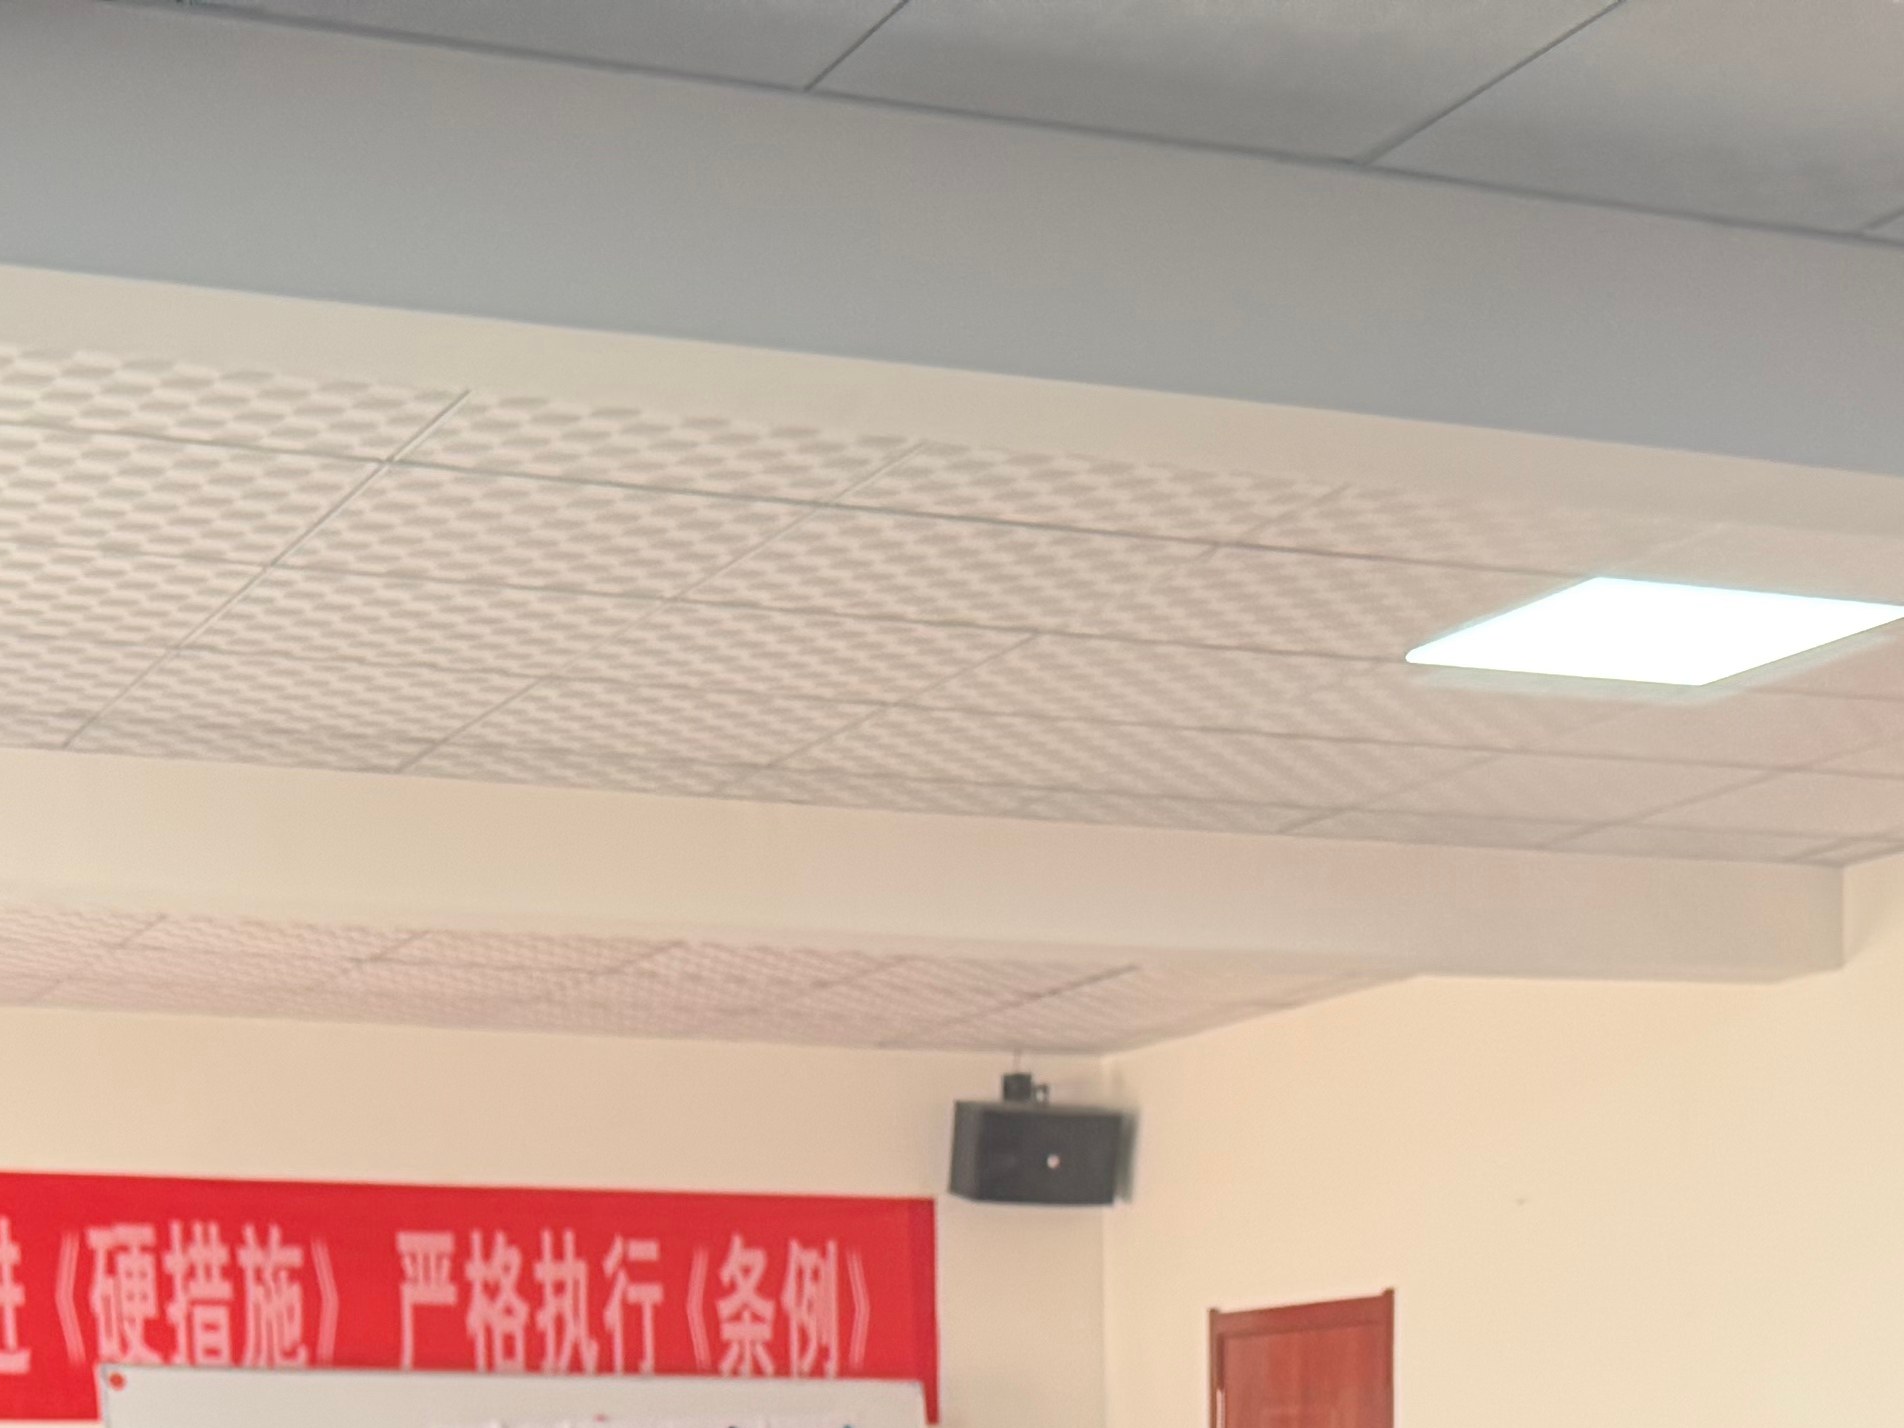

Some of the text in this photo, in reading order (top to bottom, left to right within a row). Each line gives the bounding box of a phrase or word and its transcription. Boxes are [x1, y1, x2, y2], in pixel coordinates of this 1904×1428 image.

[395, 1227, 871, 1378] 严格执行《条例》
